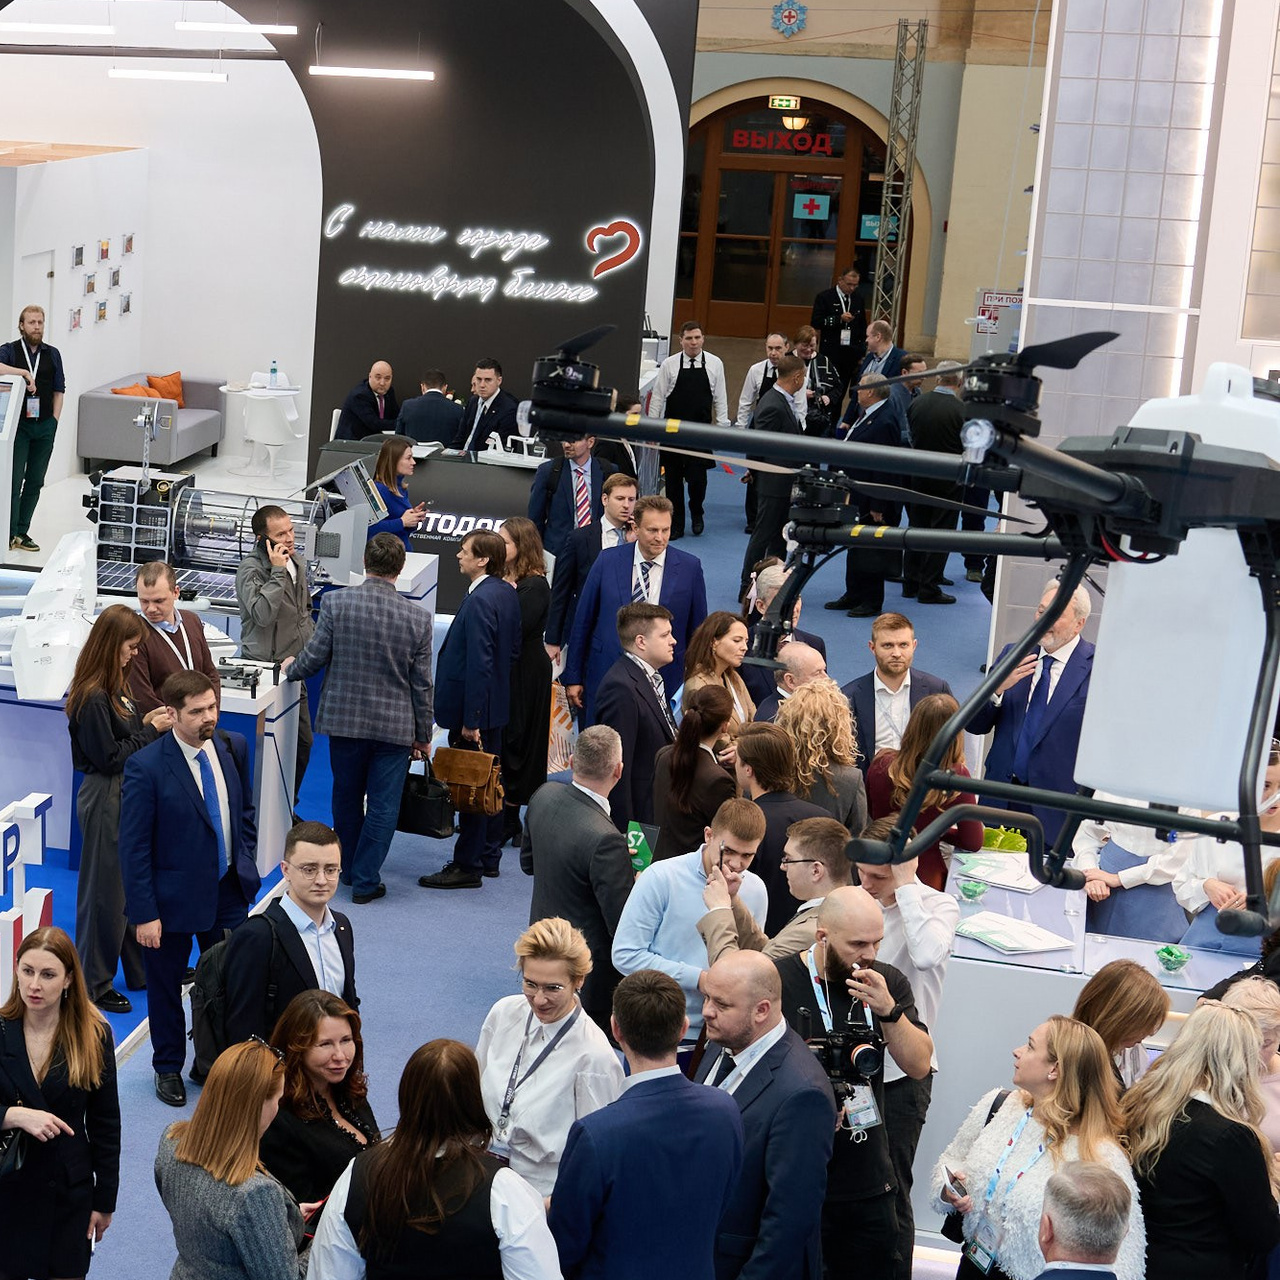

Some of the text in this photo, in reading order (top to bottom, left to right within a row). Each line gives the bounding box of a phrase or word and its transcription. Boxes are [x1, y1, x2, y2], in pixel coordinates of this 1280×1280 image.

[732, 129, 833, 156] ВЫХОД
[324, 203, 550, 262] С нами города
[338, 265, 600, 303] становятся ближе
[627, 830, 645, 848] S7
